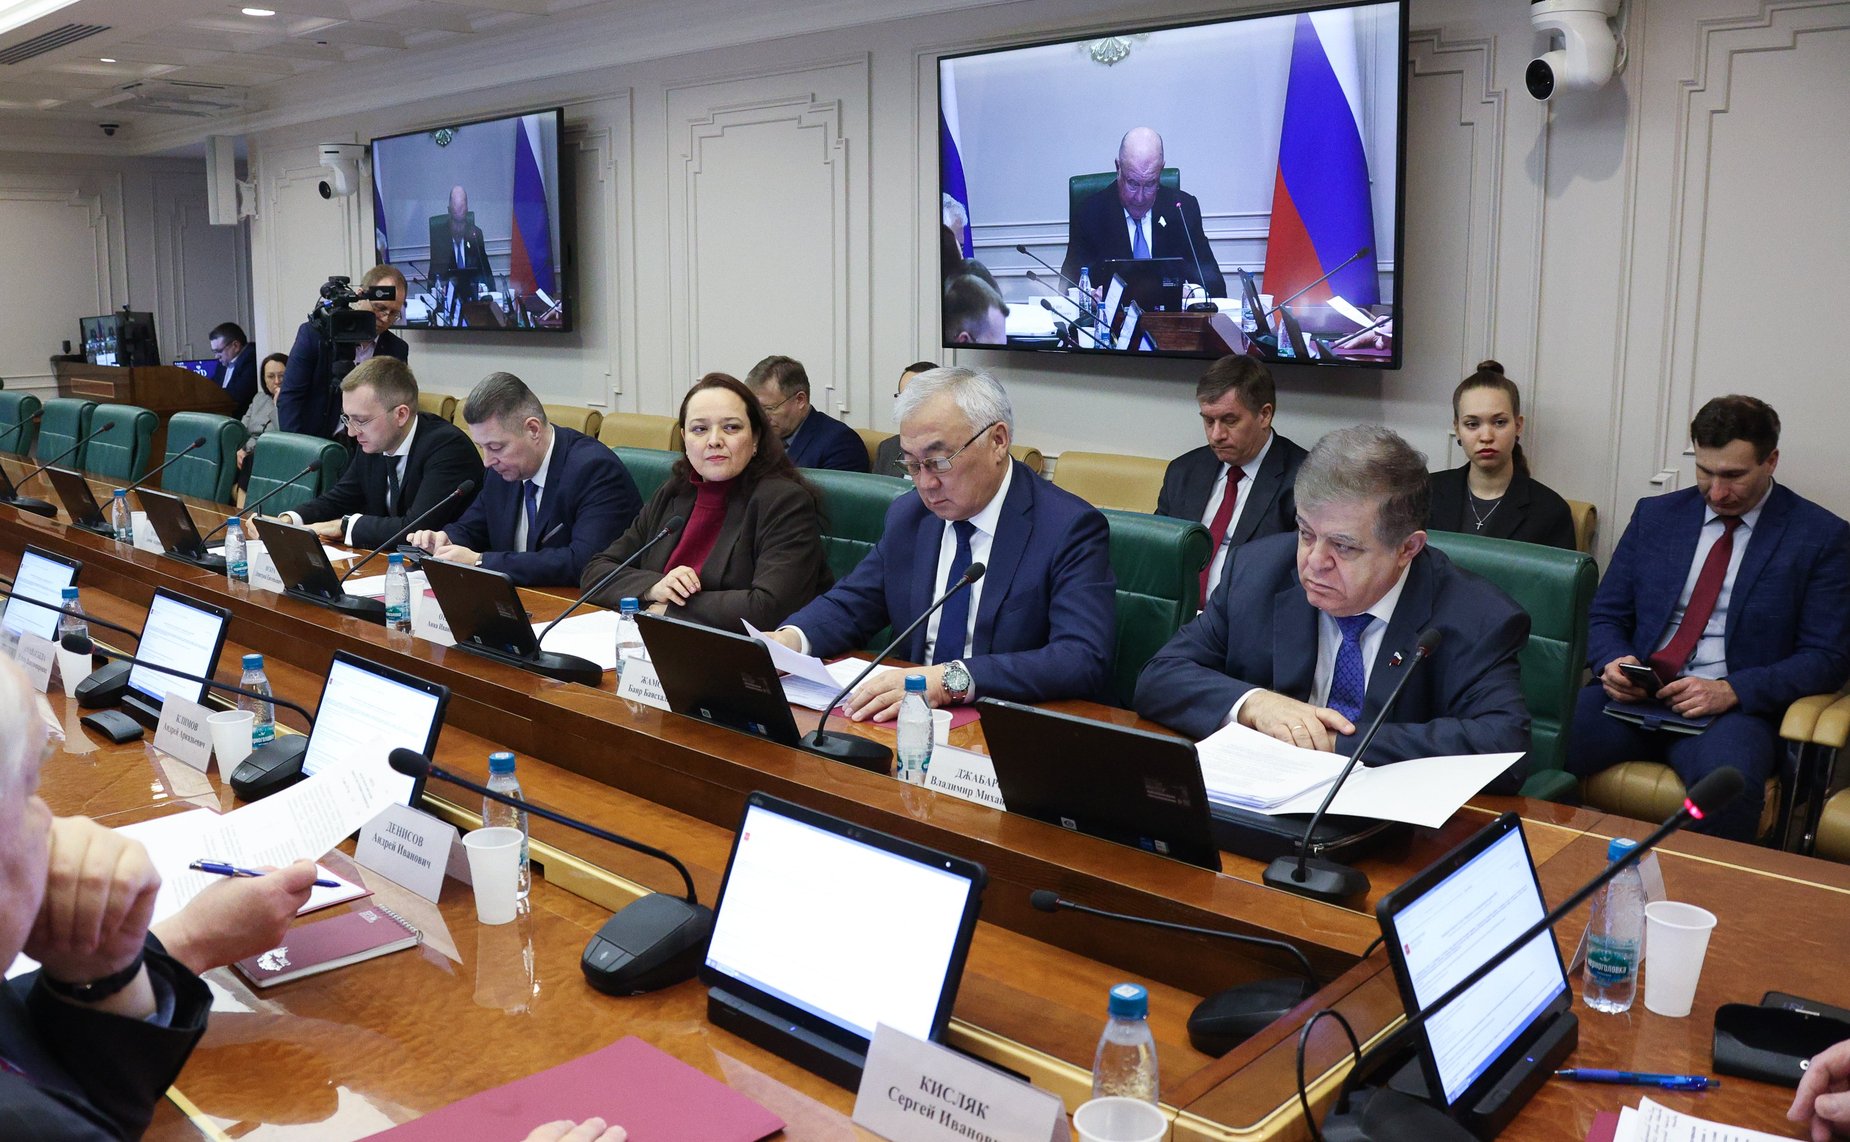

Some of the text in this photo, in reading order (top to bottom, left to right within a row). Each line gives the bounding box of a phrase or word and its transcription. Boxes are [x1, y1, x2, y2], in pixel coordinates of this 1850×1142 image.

[930, 775, 974, 797] Владимир
[372, 832, 431, 869] Андрей Иванович
[385, 821, 424, 847] ДЕНИСОВ
[888, 1086, 936, 1119] Сергей
[920, 1075, 989, 1120] КИСЛЯК
